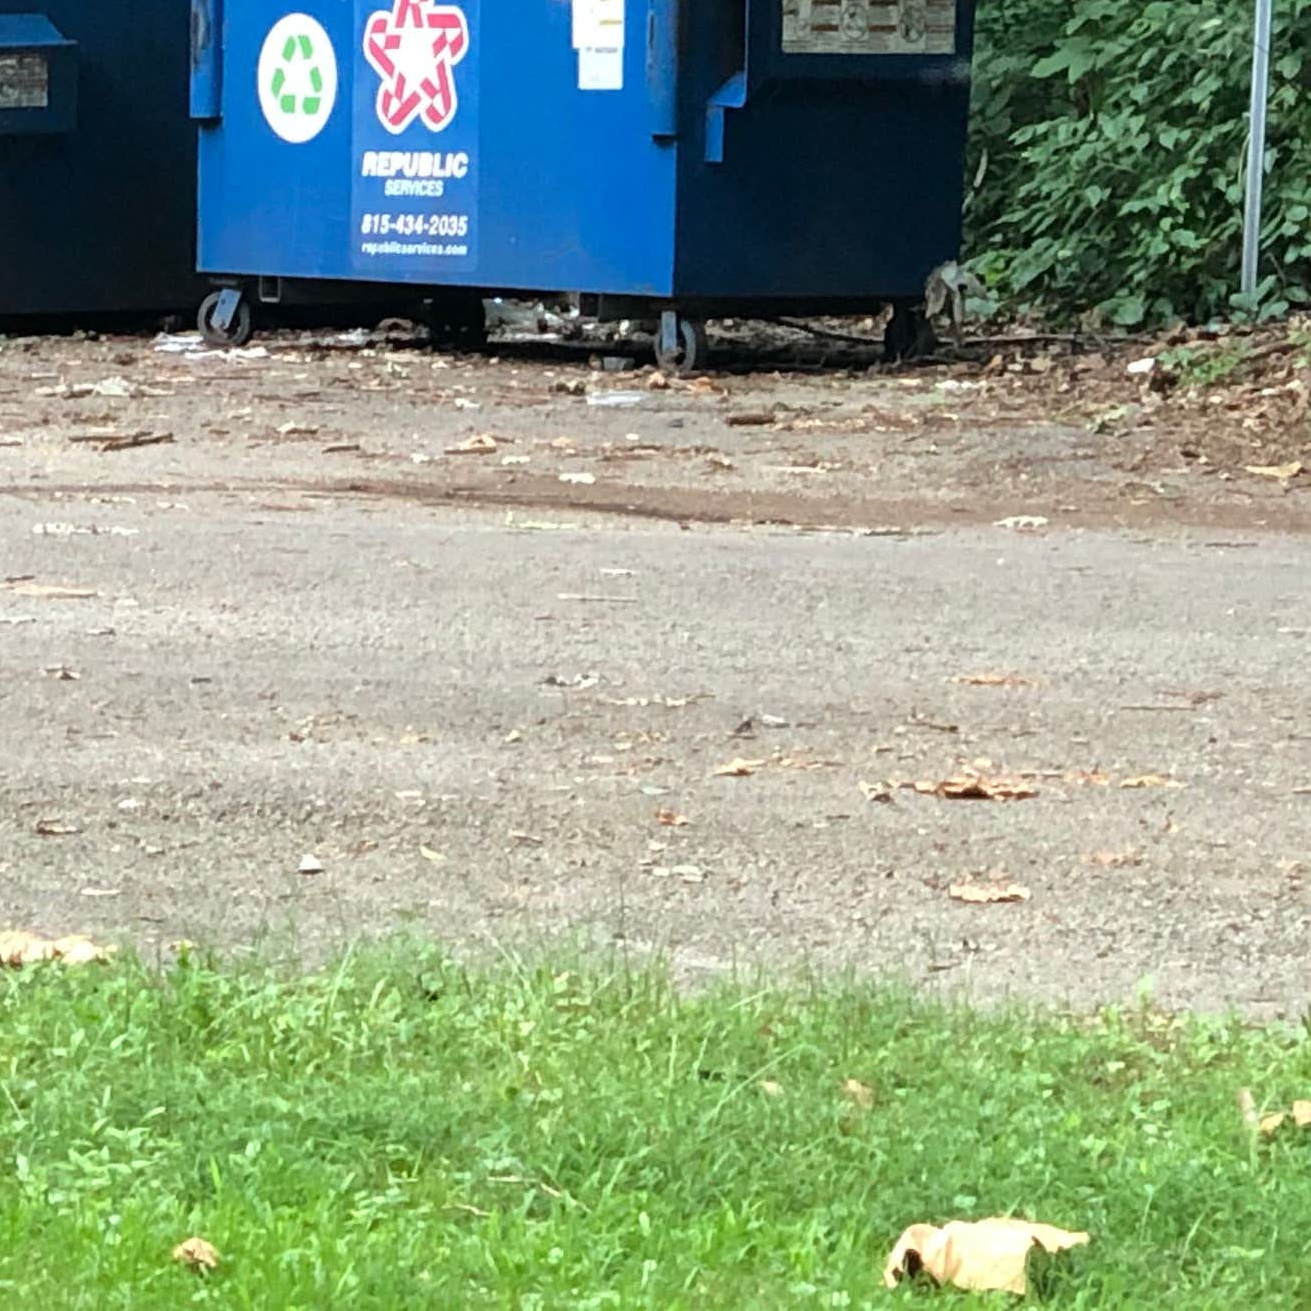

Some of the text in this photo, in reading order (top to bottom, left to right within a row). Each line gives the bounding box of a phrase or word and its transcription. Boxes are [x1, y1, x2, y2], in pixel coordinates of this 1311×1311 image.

[361, 151, 469, 178] REPUBLIC
[384, 179, 444, 196] SERVICES
[361, 213, 468, 236] 815-434-2035
[361, 241, 468, 256] republicservices.com
